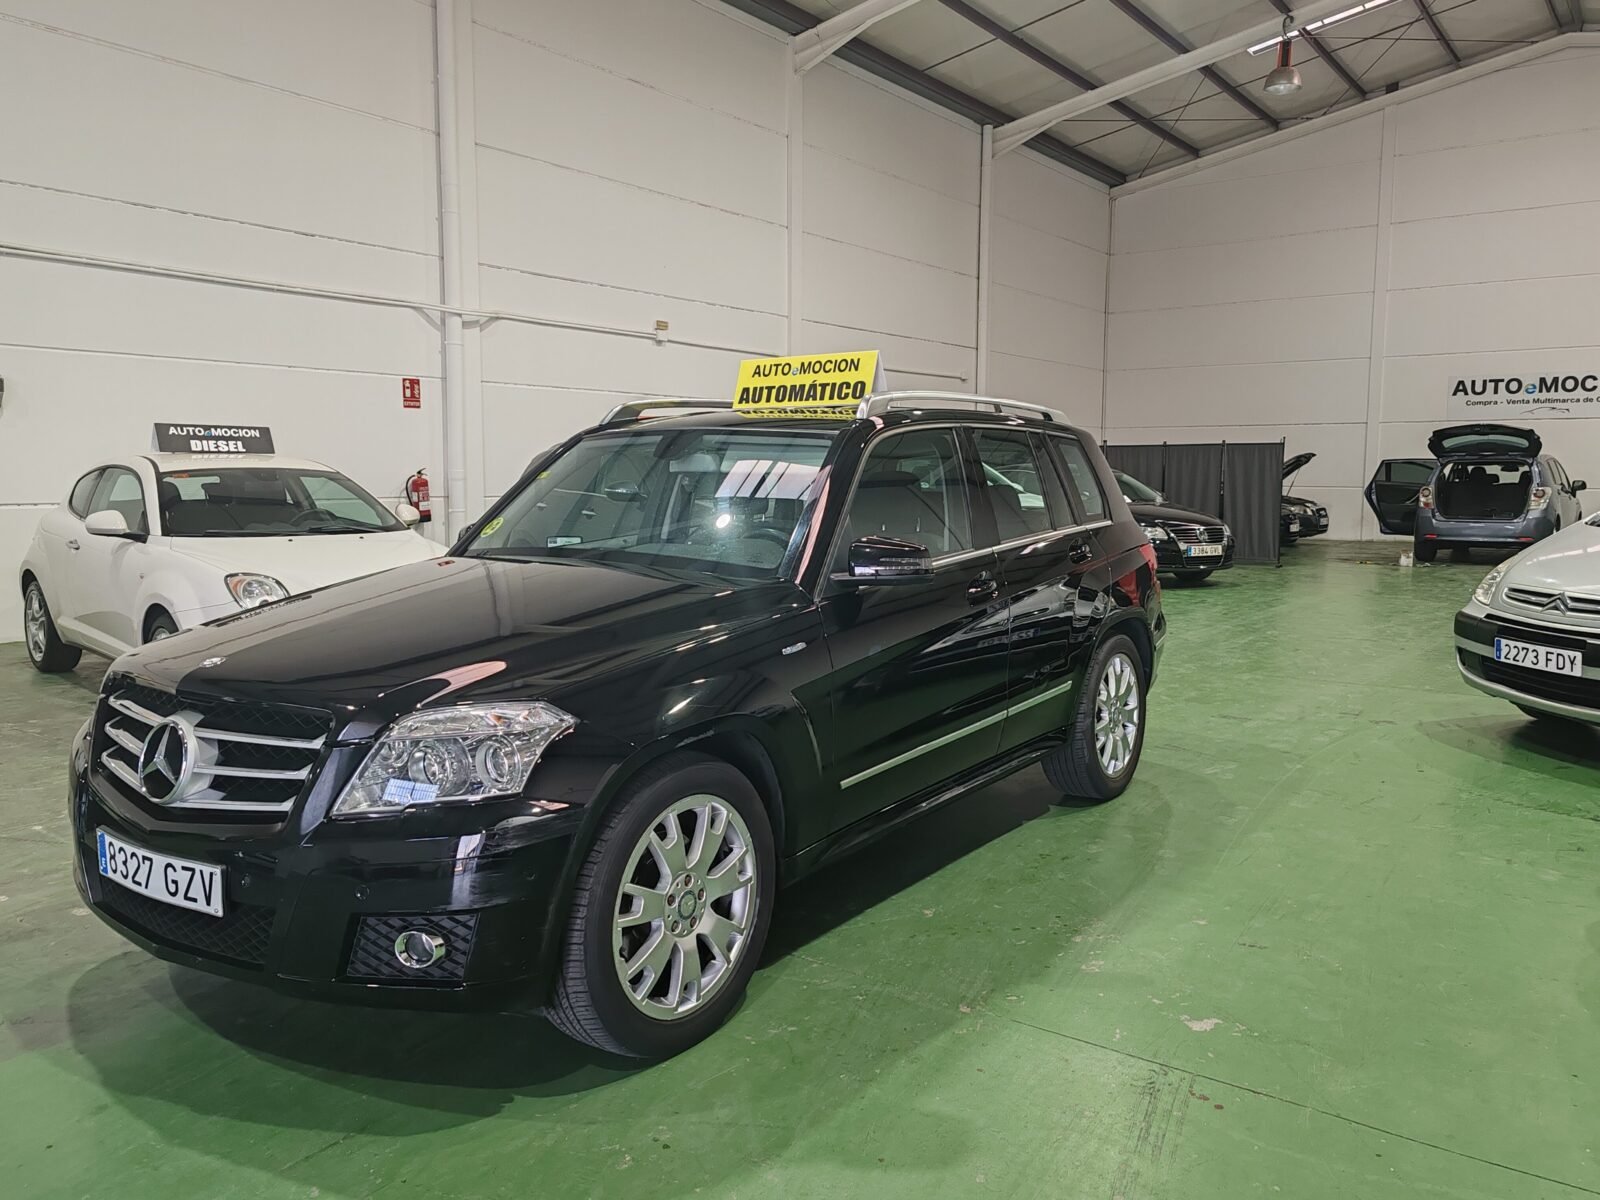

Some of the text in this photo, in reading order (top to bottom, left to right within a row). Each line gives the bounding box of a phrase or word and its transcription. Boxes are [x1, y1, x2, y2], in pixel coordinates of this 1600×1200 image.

[738, 380, 866, 404] AUTOMÁTICO
[1532, 397, 1580, 405] Multimarca
[190, 440, 246, 452] DIESEL
[1504, 644, 1577, 672] 2273 FDY
[108, 841, 213, 907] 8327 GZV
